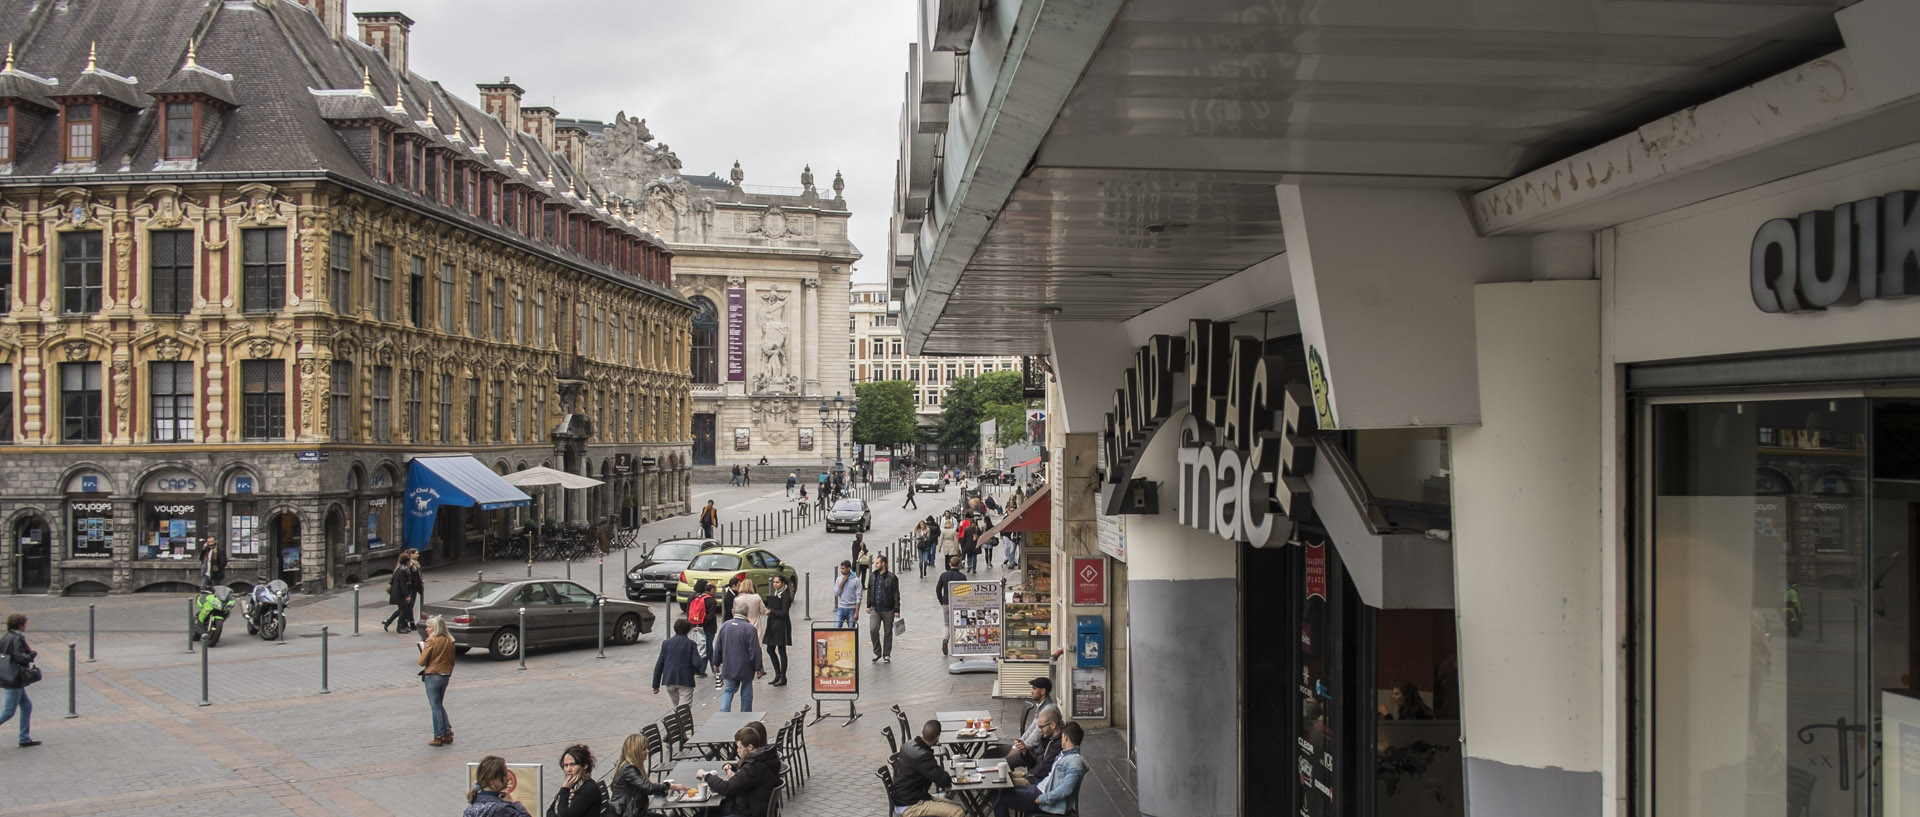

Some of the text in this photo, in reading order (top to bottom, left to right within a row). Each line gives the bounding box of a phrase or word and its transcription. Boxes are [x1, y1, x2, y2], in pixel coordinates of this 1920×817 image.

[157, 478, 197, 491] CAP5
[1178, 412, 1294, 549] fnac
[72, 503, 112, 513] voyages
[369, 498, 388, 508] voyages
[154, 505, 195, 515] voyages
[1086, 570, 1093, 578] P
[974, 583, 997, 592] JSD
[1297, 736, 1314, 754] CLEOR
